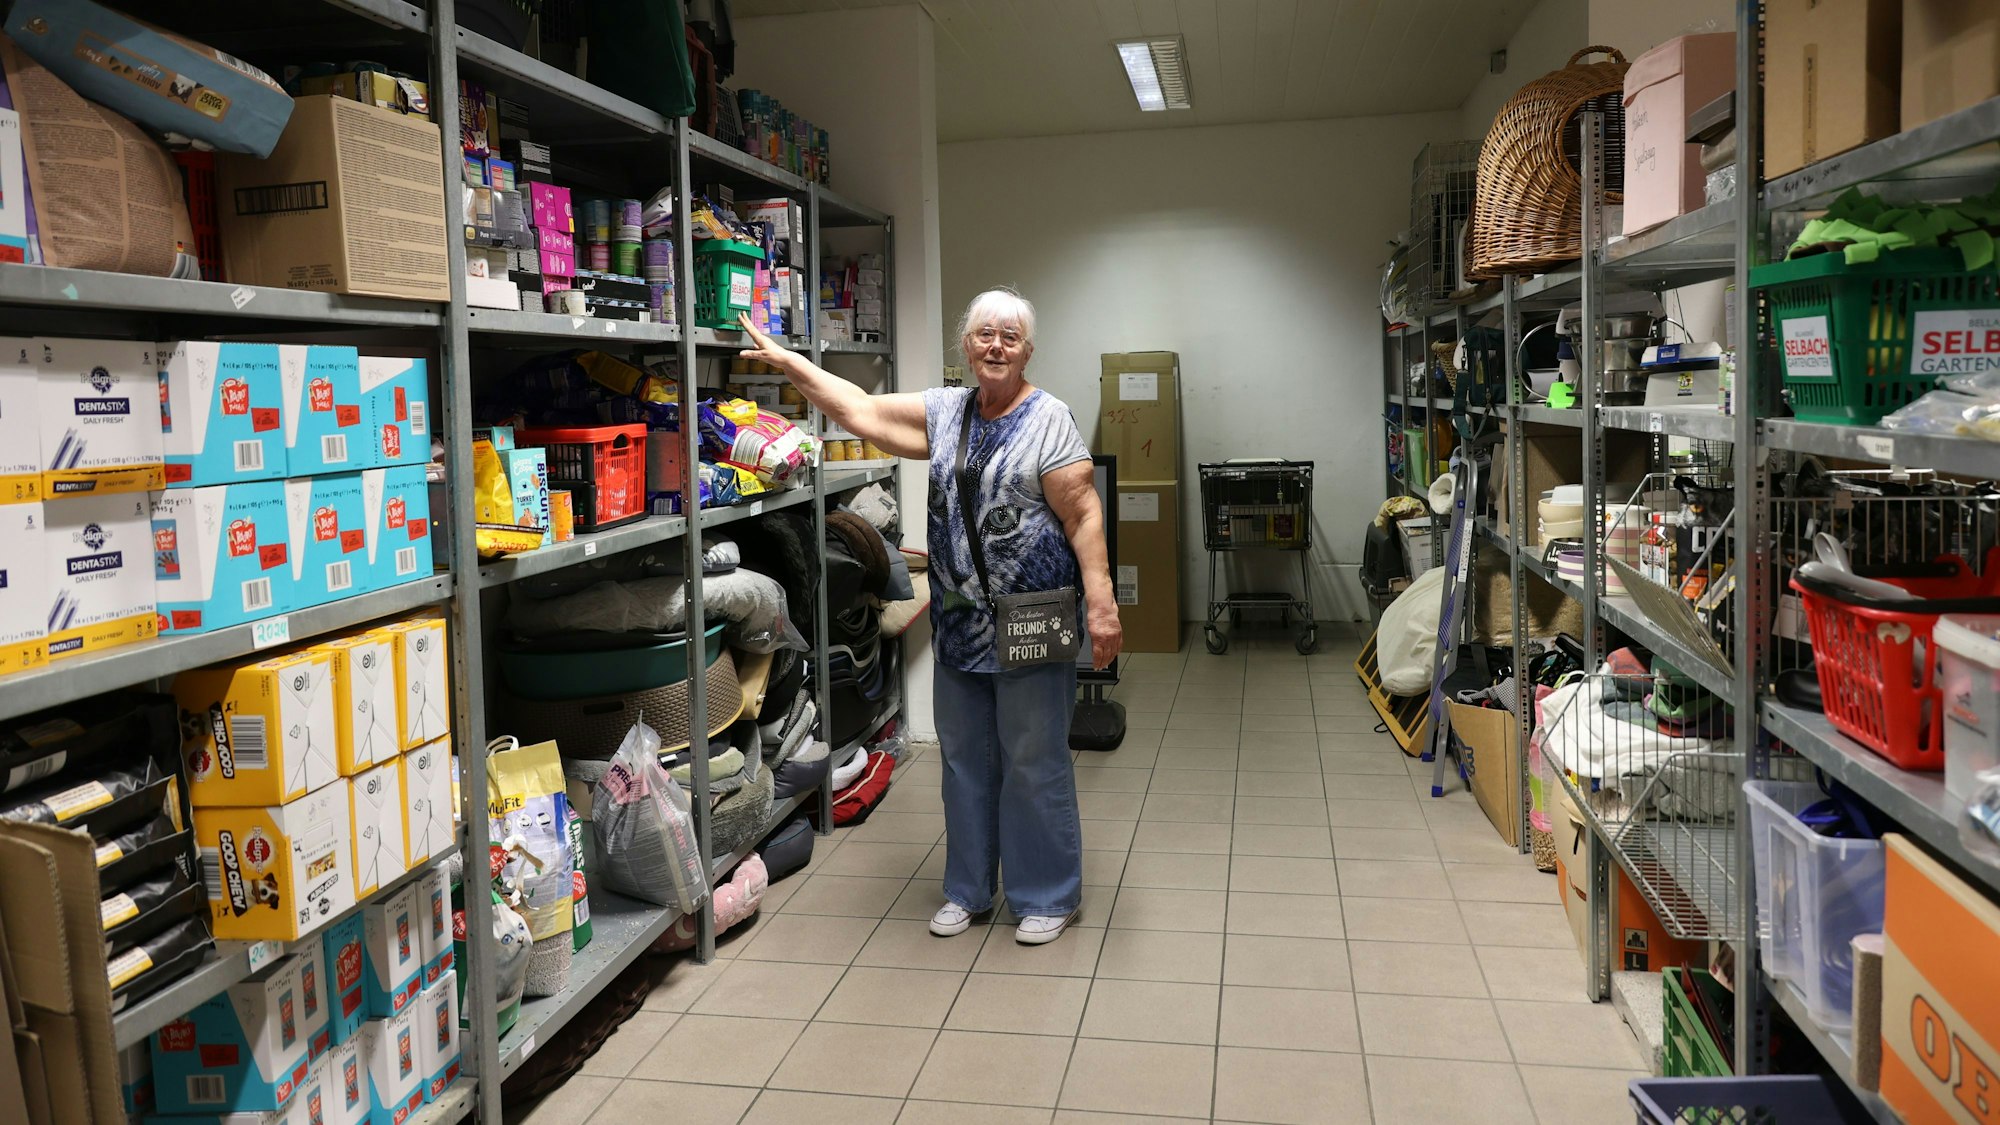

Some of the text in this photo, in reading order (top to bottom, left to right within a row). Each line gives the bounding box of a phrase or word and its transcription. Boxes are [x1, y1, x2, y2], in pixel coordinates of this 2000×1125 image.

[1784, 338, 1829, 356] SELBACH
[1922, 330, 2000, 355] SELB
[1786, 356, 1829, 368] GARTENCENTER
[80, 372, 120, 385] Pedigree
[78, 401, 126, 412] DENTASTIX
[83, 417, 101, 425] DAILY
[1141, 438, 1152, 458] 1
[516, 495, 535, 503] TURKEY
[537, 462, 550, 534] BISCUITS
[27, 515, 33, 524] 5
[72, 530, 113, 543] Pedigree
[70, 555, 119, 572] DENTASTIX
[75, 575, 94, 583] DAILY
[1009, 610, 1044, 621] Die besten
[147, 621, 152, 629] 5
[256, 622, 287, 642] 2024
[1007, 620, 1048, 636] FREUNDE
[36, 648, 41, 656] 5
[1009, 643, 1048, 661] PFOTEN
[210, 708, 234, 778] GOOD CHEW
[253, 826, 263, 873] Pedigree
[220, 832, 246, 910] GOOD CHEW
[1632, 954, 1640, 968] L
[1911, 995, 2000, 1125] OB
